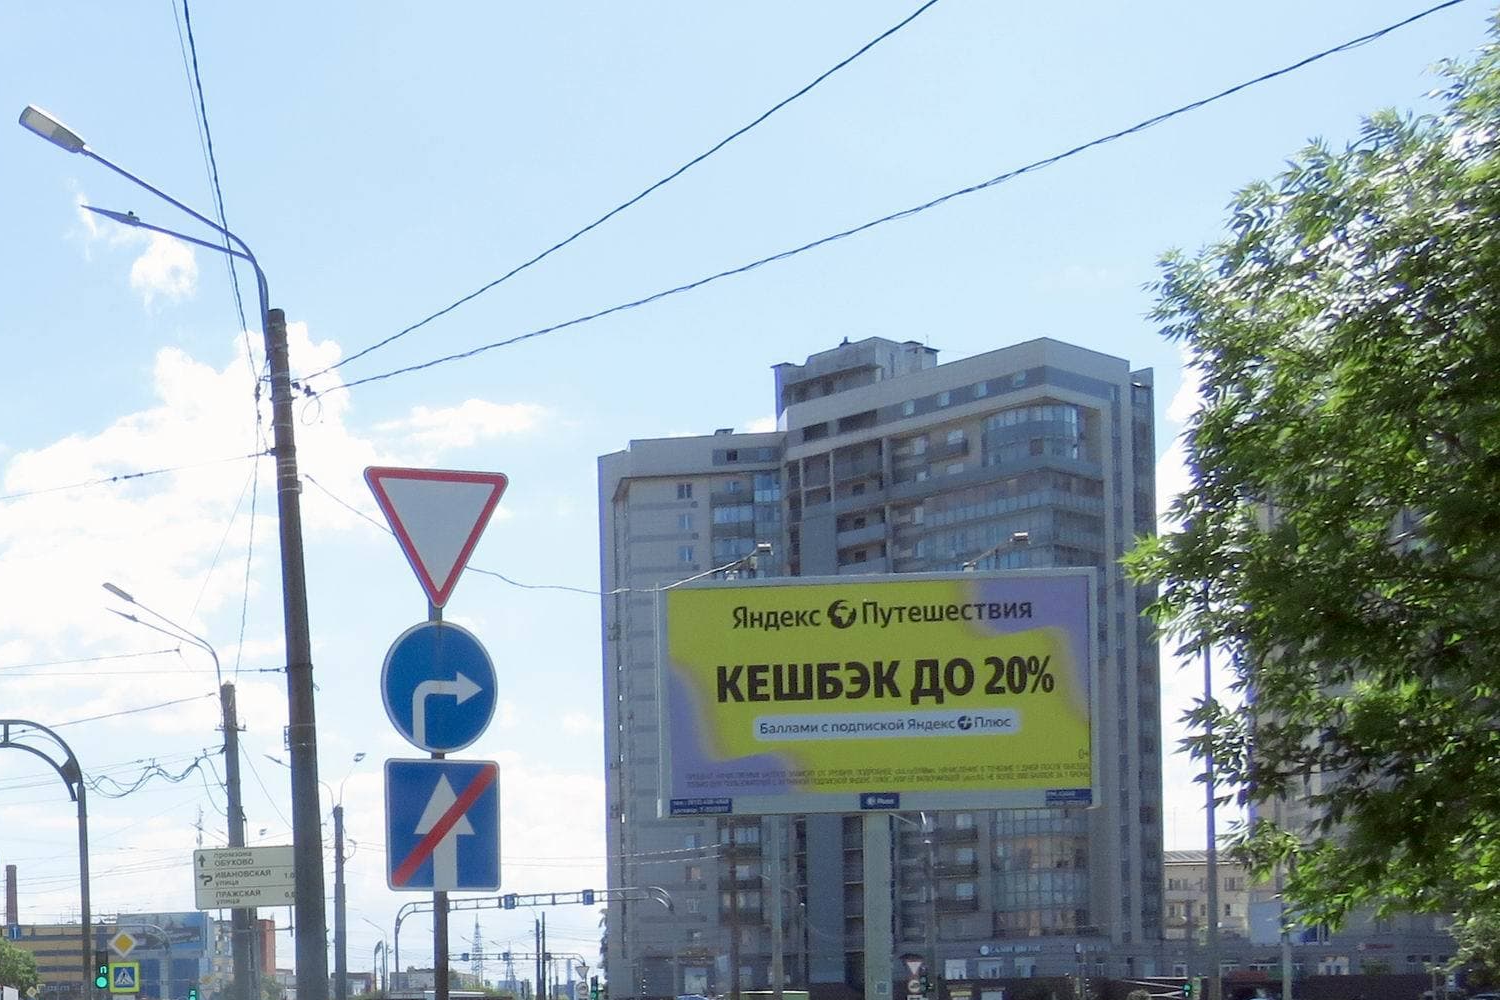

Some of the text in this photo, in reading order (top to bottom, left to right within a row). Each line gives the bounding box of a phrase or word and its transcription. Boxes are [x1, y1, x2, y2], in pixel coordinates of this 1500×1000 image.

[732, 600, 1033, 631] Яндекс Путешествия
[716, 654, 1055, 705] КЕШБЭК ДО 20%
[759, 715, 1012, 736] Баллами с подпиской Яндекс Плюс
[214, 858, 254, 867] ОБУХОВО
[214, 868, 272, 879] ИВАНОВСКАЯ
[215, 879, 240, 888] улица
[215, 889, 261, 899] ПРАЖСКАЯ
